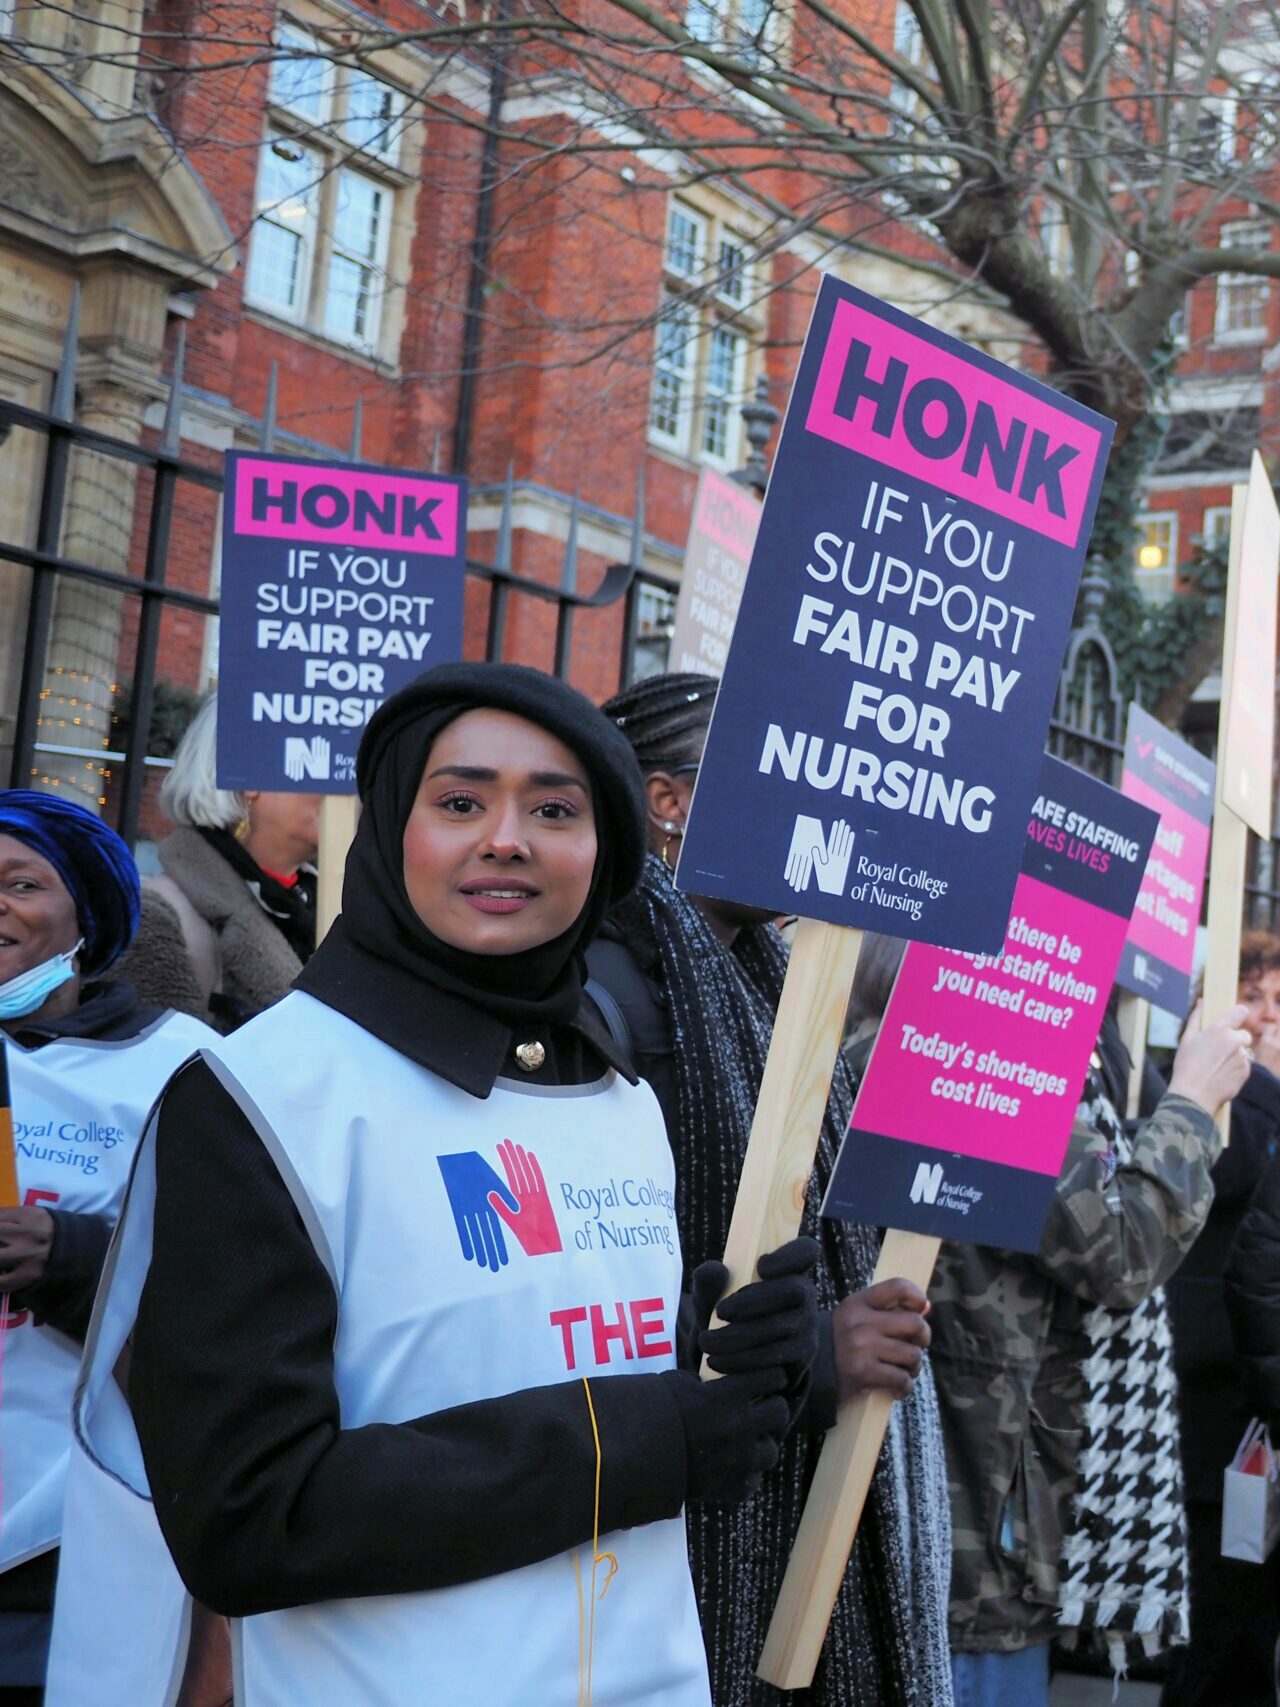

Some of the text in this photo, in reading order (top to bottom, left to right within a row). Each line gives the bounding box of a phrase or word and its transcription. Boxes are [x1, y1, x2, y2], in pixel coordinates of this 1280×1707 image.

[833, 337, 1081, 520] HONK
[251, 477, 444, 541] HONK
[704, 487, 753, 543] HON
[861, 481, 1014, 582] IF YOU
[288, 549, 407, 588] IF YOU
[707, 545, 720, 570] IF
[256, 583, 434, 626] SUPPORT
[806, 531, 1035, 655] SUPPORT
[257, 619, 431, 660] FAIR PAY
[793, 594, 1021, 713] FAIR PAY
[304, 658, 384, 693] FOR
[252, 691, 387, 728] NURSI
[843, 680, 951, 758] FOR
[758, 723, 996, 833] NURSING
[1027, 819, 1111, 873] AVES LIVES
[1031, 795, 1140, 863] AFE STAFFING
[856, 855, 949, 900] Royal College
[851, 882, 924, 921] of Nursing
[1154, 894, 1189, 938] lives
[1007, 916, 1082, 964] there be
[932, 966, 1073, 1029] you need care?
[1001, 953, 1049, 986] staff
[1048, 971, 1097, 1005] when
[975, 1050, 1067, 1096] shortages
[931, 1076, 1021, 1117] cost lives
[12, 1121, 125, 1149] oyal College
[16, 1142, 100, 1175] Nursing
[560, 1178, 675, 1220] Royal Colleg
[936, 1196, 970, 1216] of Nursing
[941, 1181, 983, 1203] Royal College
[574, 1218, 675, 1256] of Nursing
[550, 1297, 673, 1371] THE
